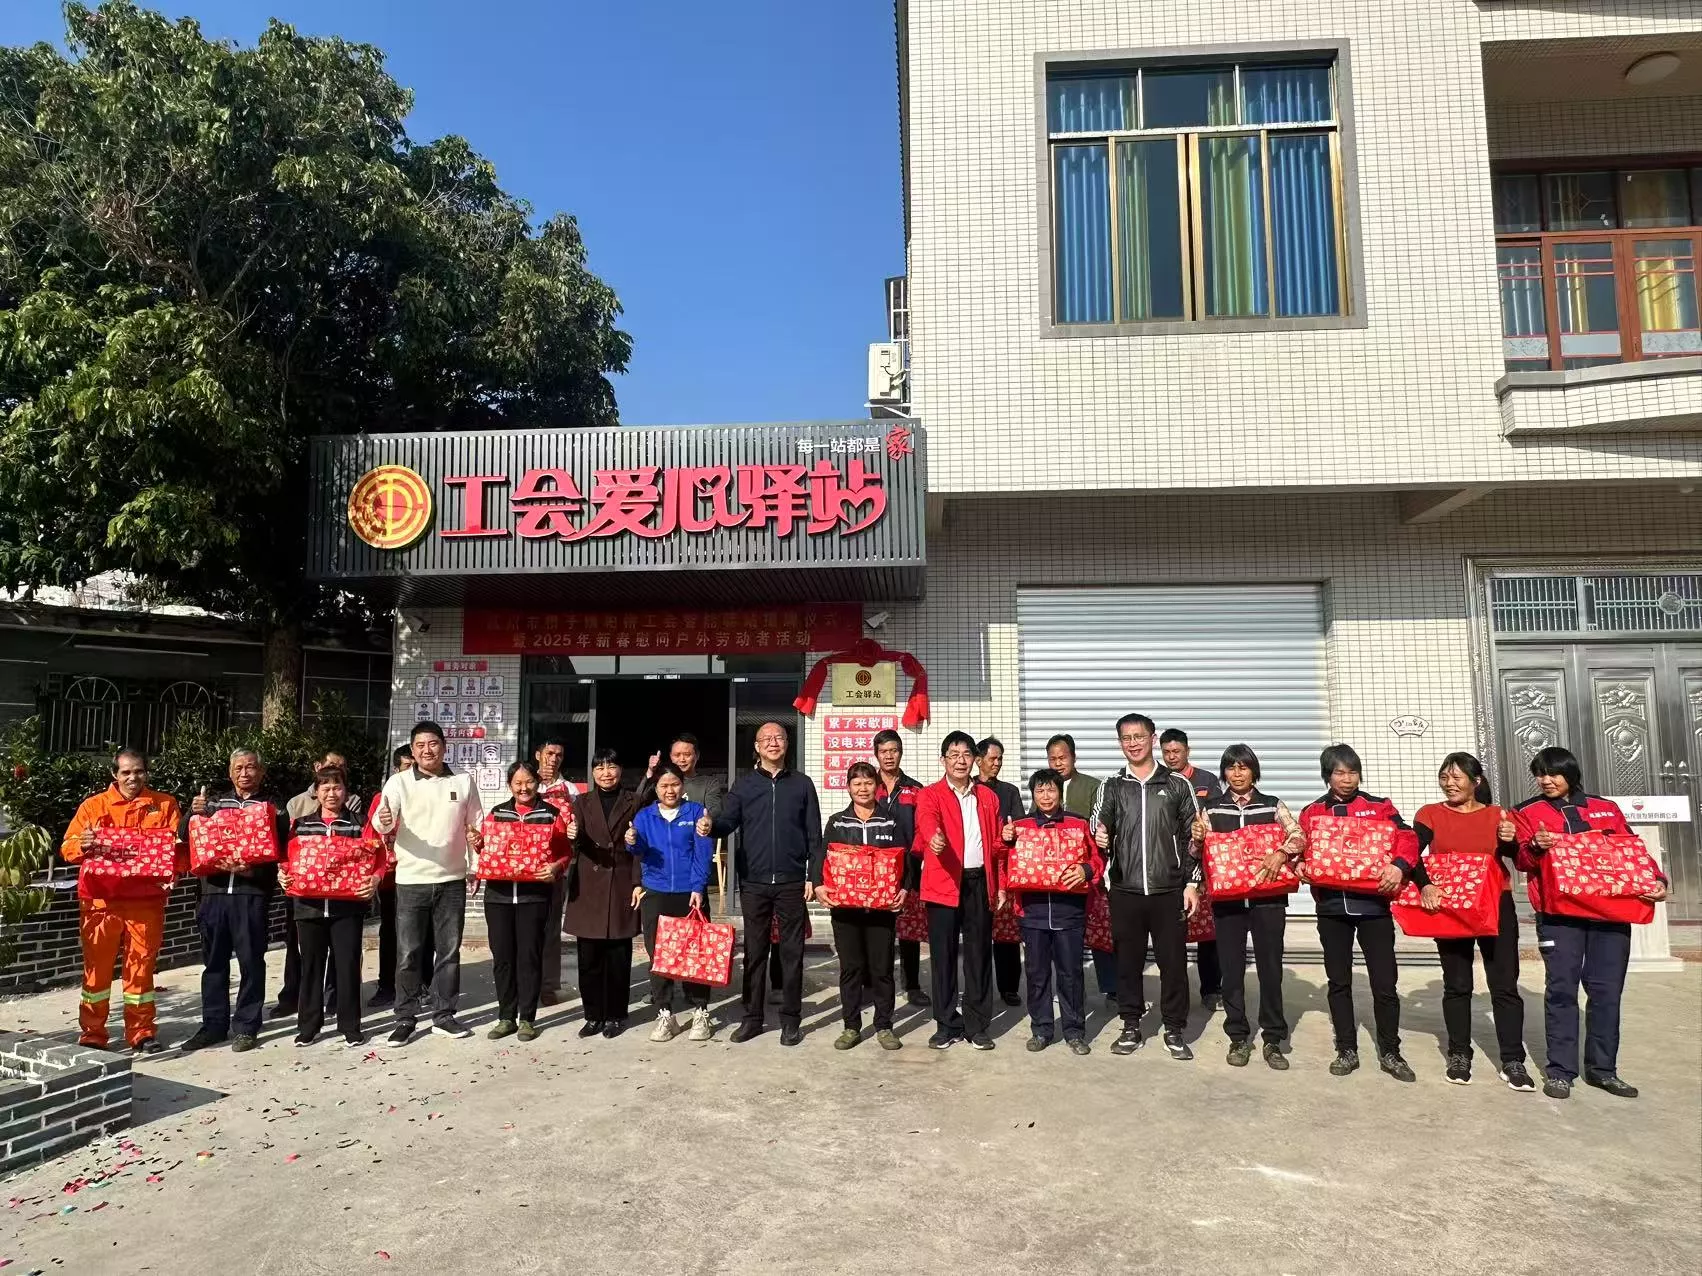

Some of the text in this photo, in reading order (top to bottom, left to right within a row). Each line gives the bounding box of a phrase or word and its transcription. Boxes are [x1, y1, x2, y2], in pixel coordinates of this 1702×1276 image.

[797, 425, 914, 461] 每一站都是家
[440, 458, 888, 544] 工会爱心驿站
[846, 690, 881, 699] 工会驿站
[829, 717, 894, 728] 累了来歇脚
